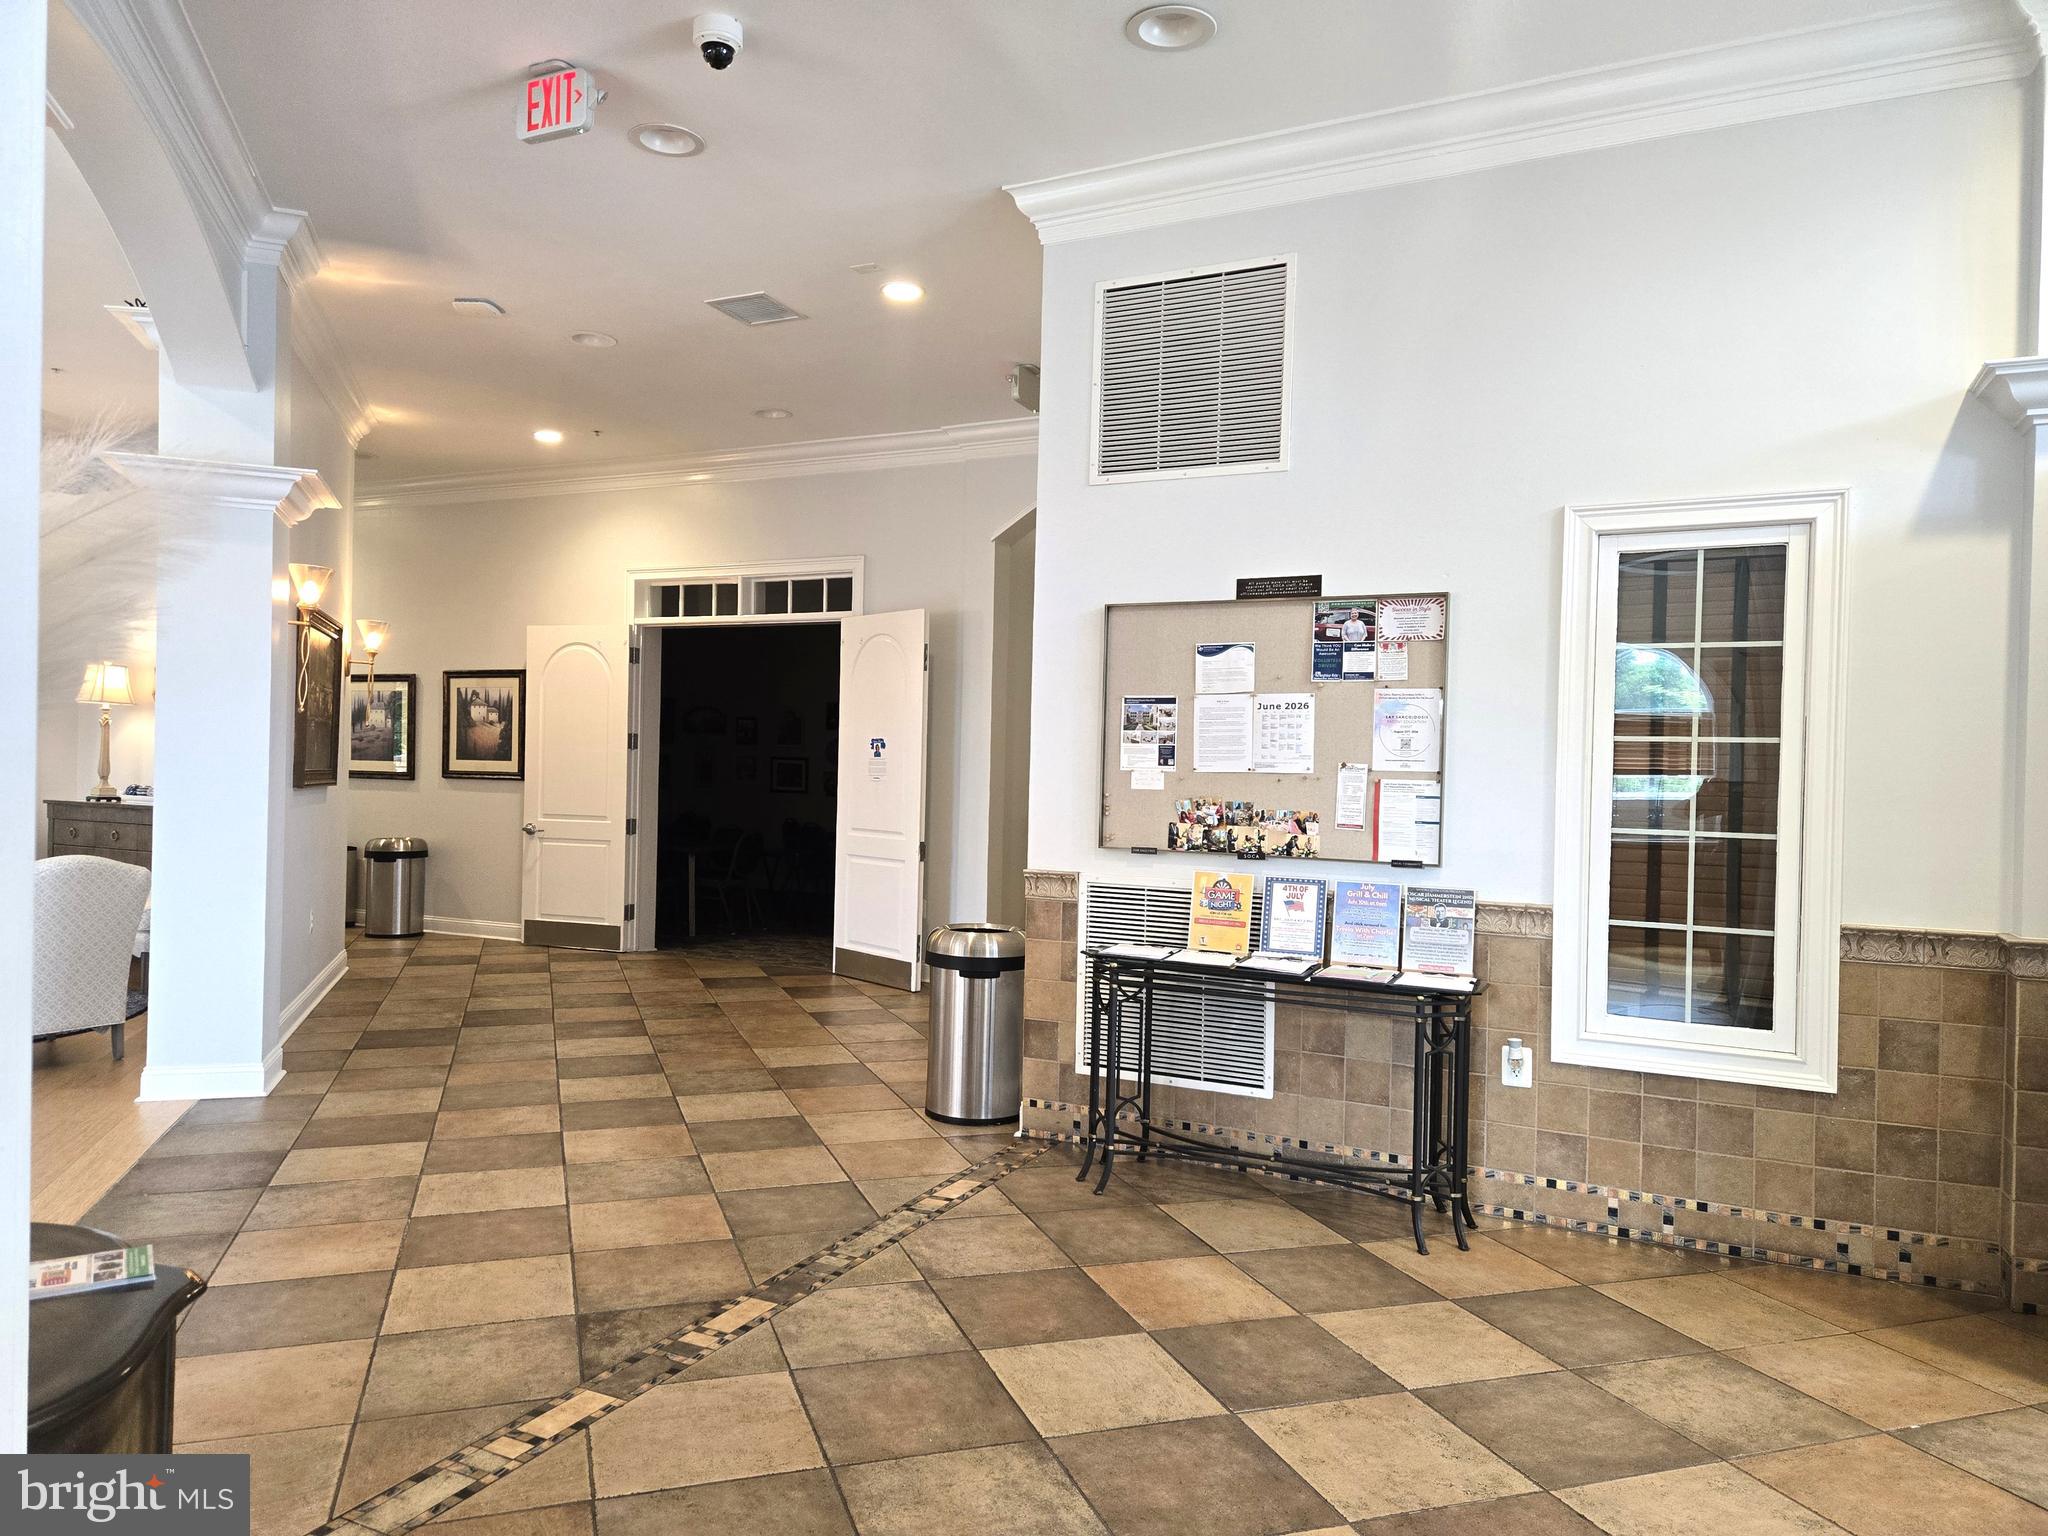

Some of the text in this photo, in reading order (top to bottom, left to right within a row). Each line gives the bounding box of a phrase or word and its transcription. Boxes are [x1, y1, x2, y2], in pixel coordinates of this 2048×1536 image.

[527, 71, 576, 132] EXIT
[1419, 605, 1431, 613] Style
[1257, 702, 1310, 710] June 2026
[1282, 884, 1298, 892] 4TH
[1360, 883, 1376, 892] July
[1207, 890, 1236, 900] GAME
[1346, 890, 1363, 898] Grill
[1371, 891, 1388, 899] Chill
[1335, 925, 1354, 933] Trivia
